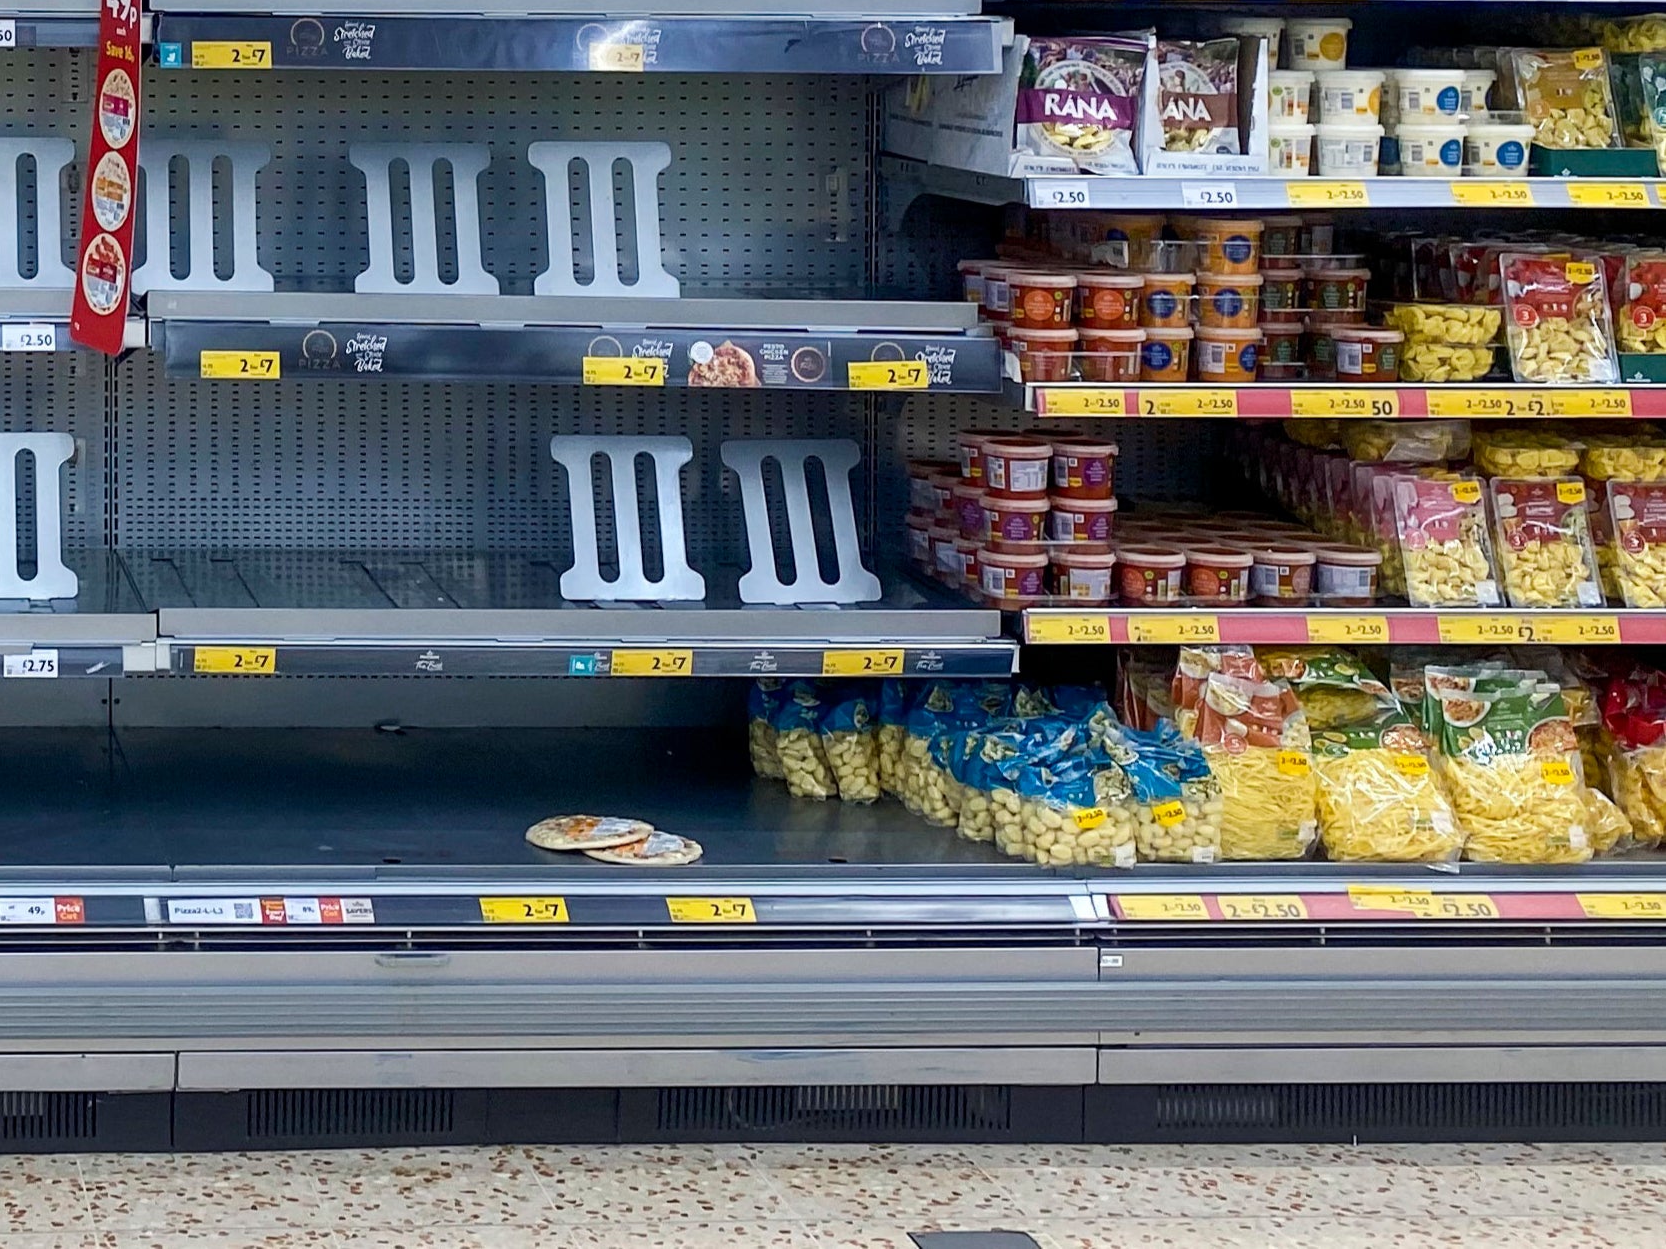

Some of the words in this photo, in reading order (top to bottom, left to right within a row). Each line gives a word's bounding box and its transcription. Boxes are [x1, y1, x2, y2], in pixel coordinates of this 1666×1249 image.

[231, 48, 241, 63] 2
[252, 48, 266, 63] £7
[1044, 93, 1118, 121] RANA
[1162, 97, 1212, 122] ANA
[1052, 191, 1085, 203] £2.50
[1200, 191, 1233, 204] £2.50
[21, 333, 53, 347] £2.50
[240, 358, 249, 373] 2
[260, 358, 274, 374] £7
[623, 365, 633, 380] 2
[644, 365, 658, 380] £7
[887, 368, 897, 384] 2
[908, 368, 922, 384] £7
[1505, 400, 1515, 416] 2
[22, 659, 55, 673] £2.75
[234, 654, 243, 668] 2
[255, 654, 269, 668] £7
[652, 656, 661, 670] 2
[673, 656, 687, 670] £7
[863, 656, 872, 670] 2
[884, 656, 898, 670] £7
[522, 903, 534, 917] 2
[545, 903, 559, 917] £7
[710, 903, 722, 917] 2
[732, 903, 746, 917] £7
[1252, 904, 1301, 918] £2.50
